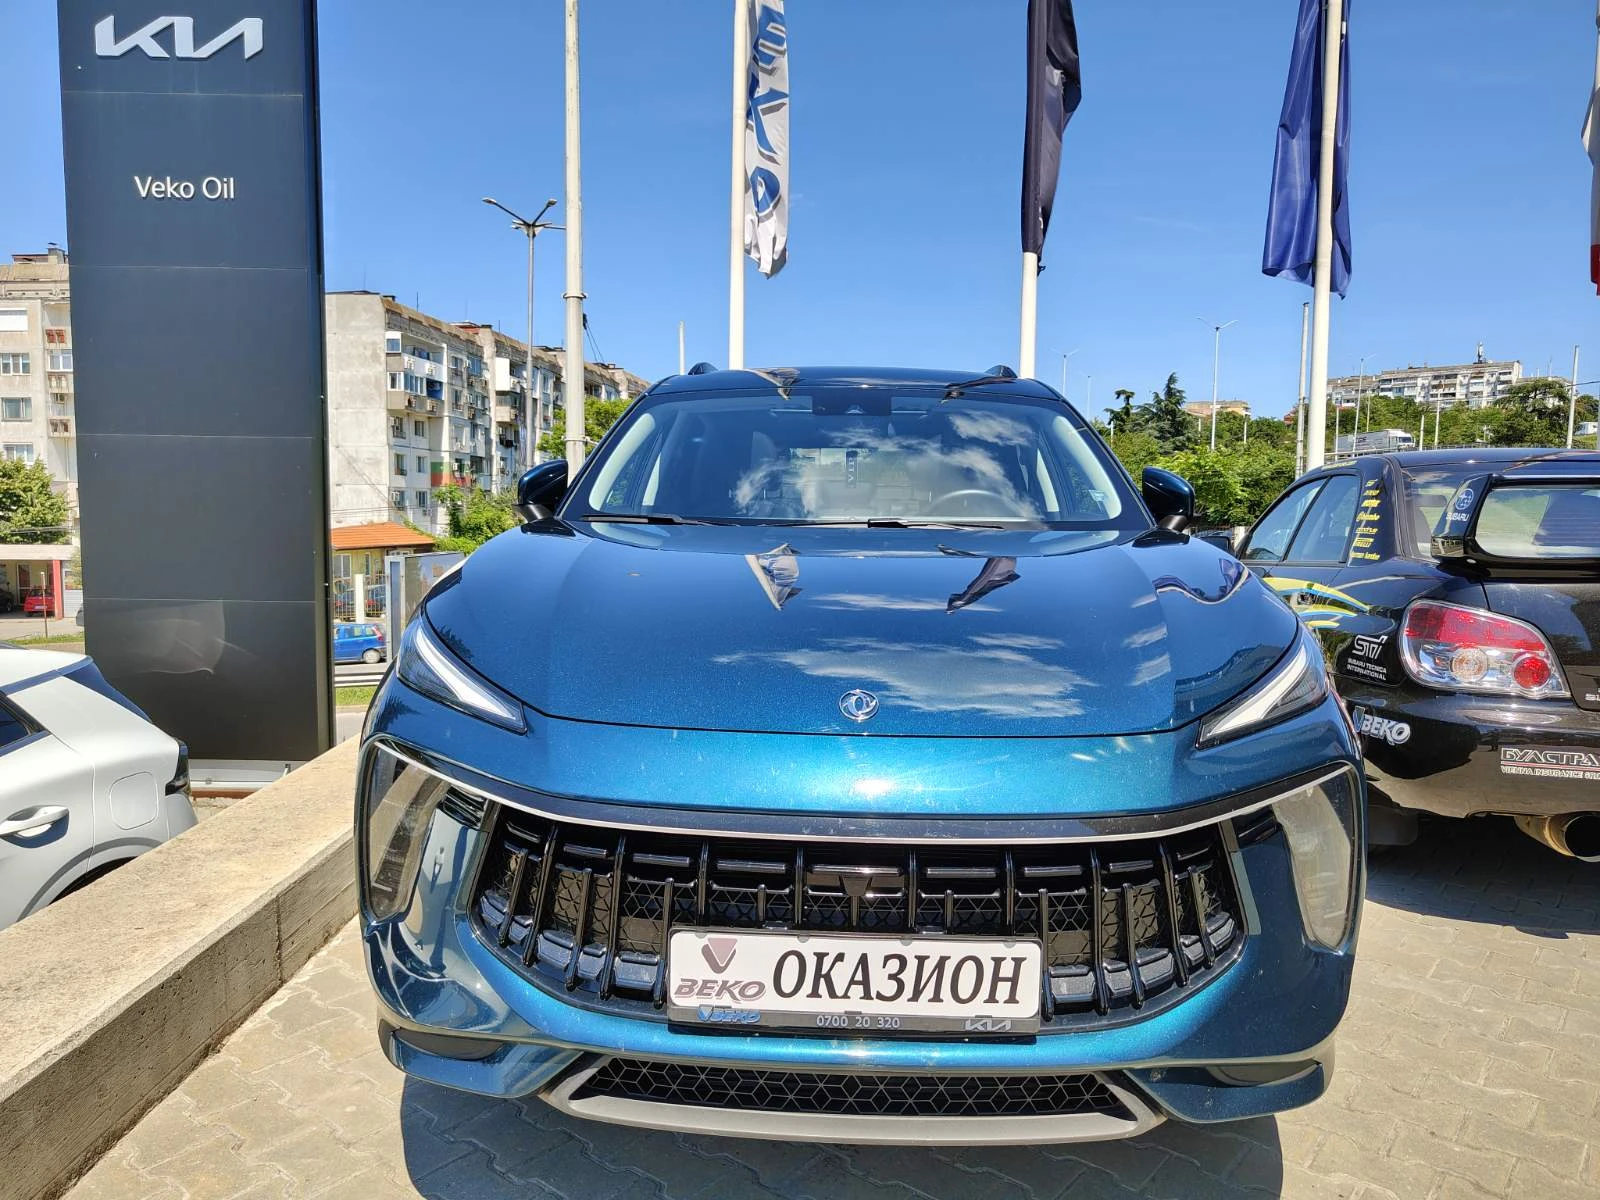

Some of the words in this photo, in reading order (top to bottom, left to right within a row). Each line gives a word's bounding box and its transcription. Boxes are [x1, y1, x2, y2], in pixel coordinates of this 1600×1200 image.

[134, 176, 195, 199] Veko
[202, 177, 235, 199] Oil
[1346, 664, 1387, 681] INTERNATIONAL
[1501, 747, 1600, 767] БУЛСТРА
[772, 949, 1028, 1005] ОКАЗИОН
[816, 1015, 848, 1027] 0700
[855, 1015, 870, 1028] 20
[877, 1016, 900, 1029] 320
